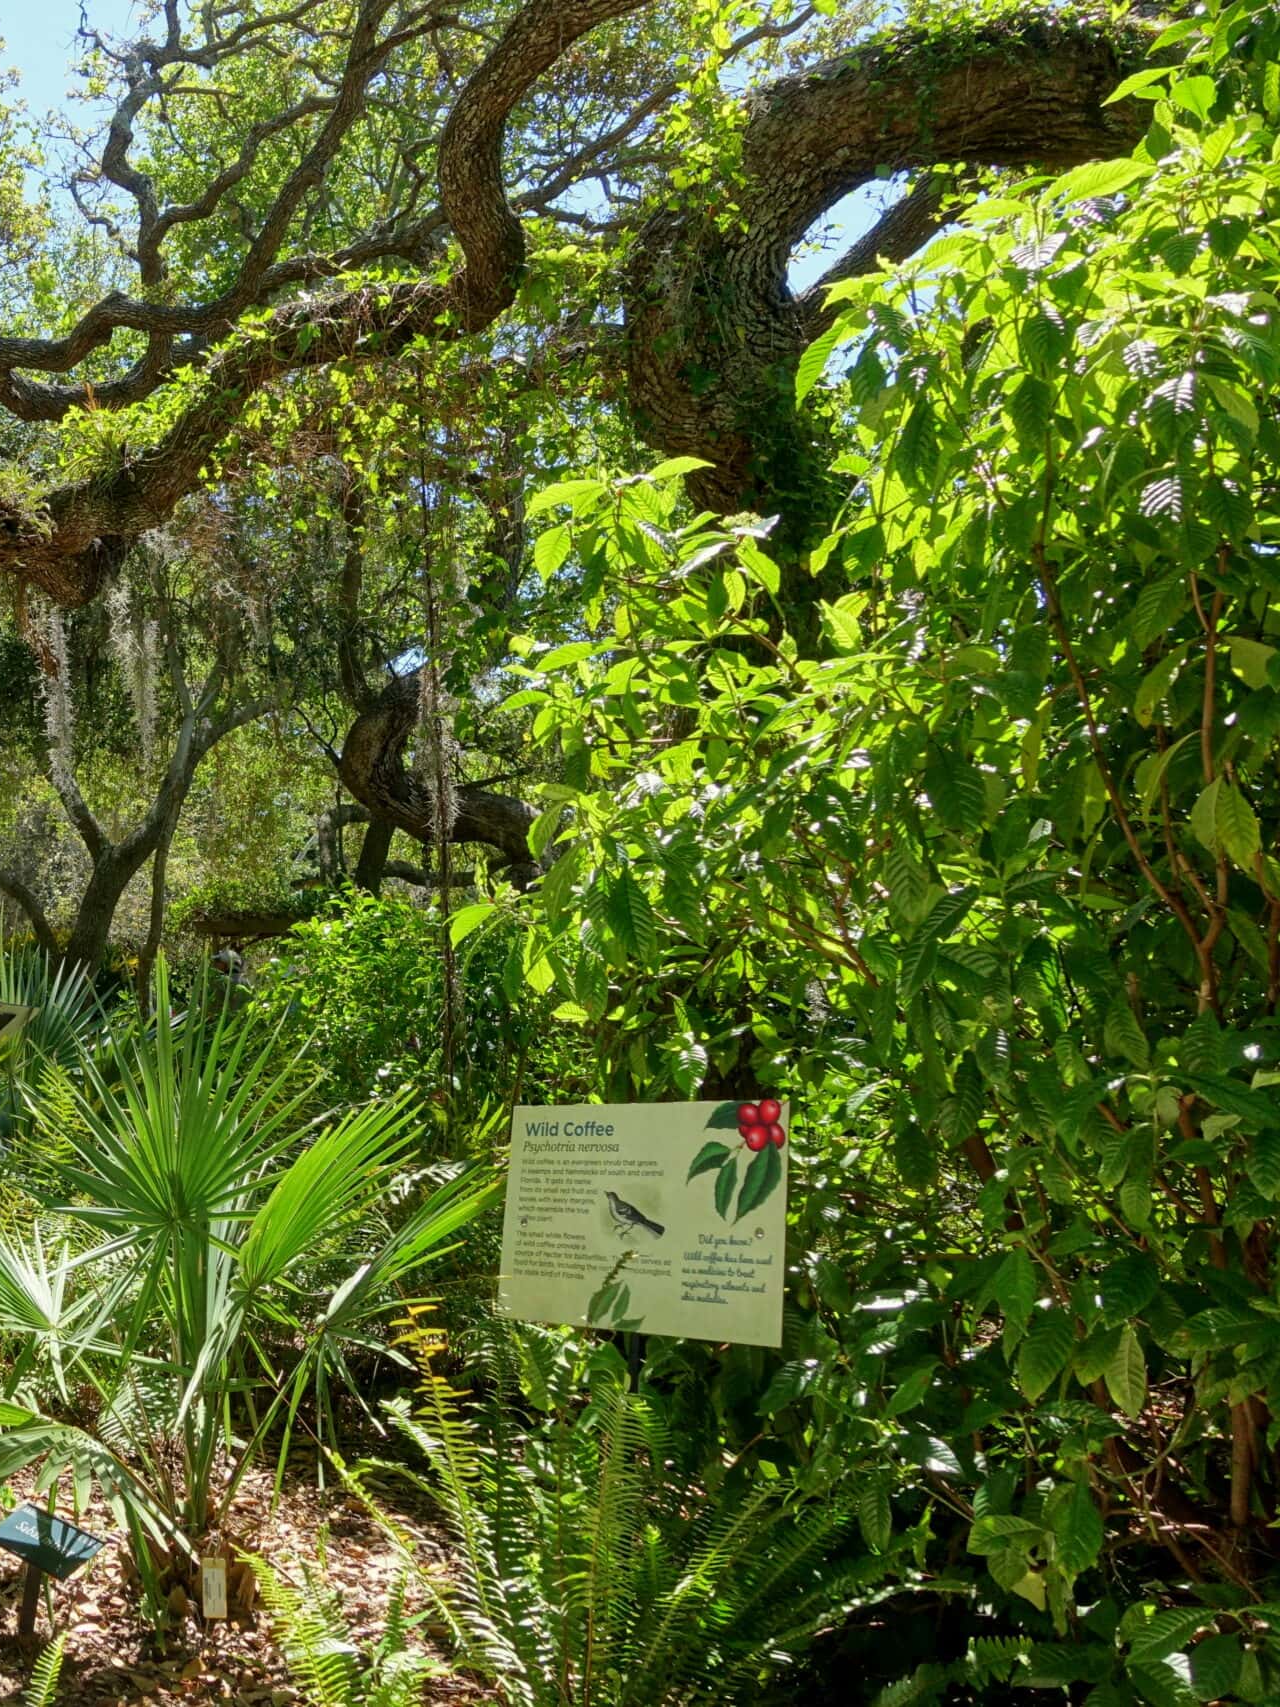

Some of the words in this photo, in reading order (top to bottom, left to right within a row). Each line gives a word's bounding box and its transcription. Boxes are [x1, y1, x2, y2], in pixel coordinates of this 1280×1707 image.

[526, 1121, 559, 1137] Wild
[563, 1121, 614, 1137] Coffee
[523, 1140, 575, 1155] Psychotria
[578, 1143, 620, 1153] nervosa
[698, 1233, 713, 1245] Did
